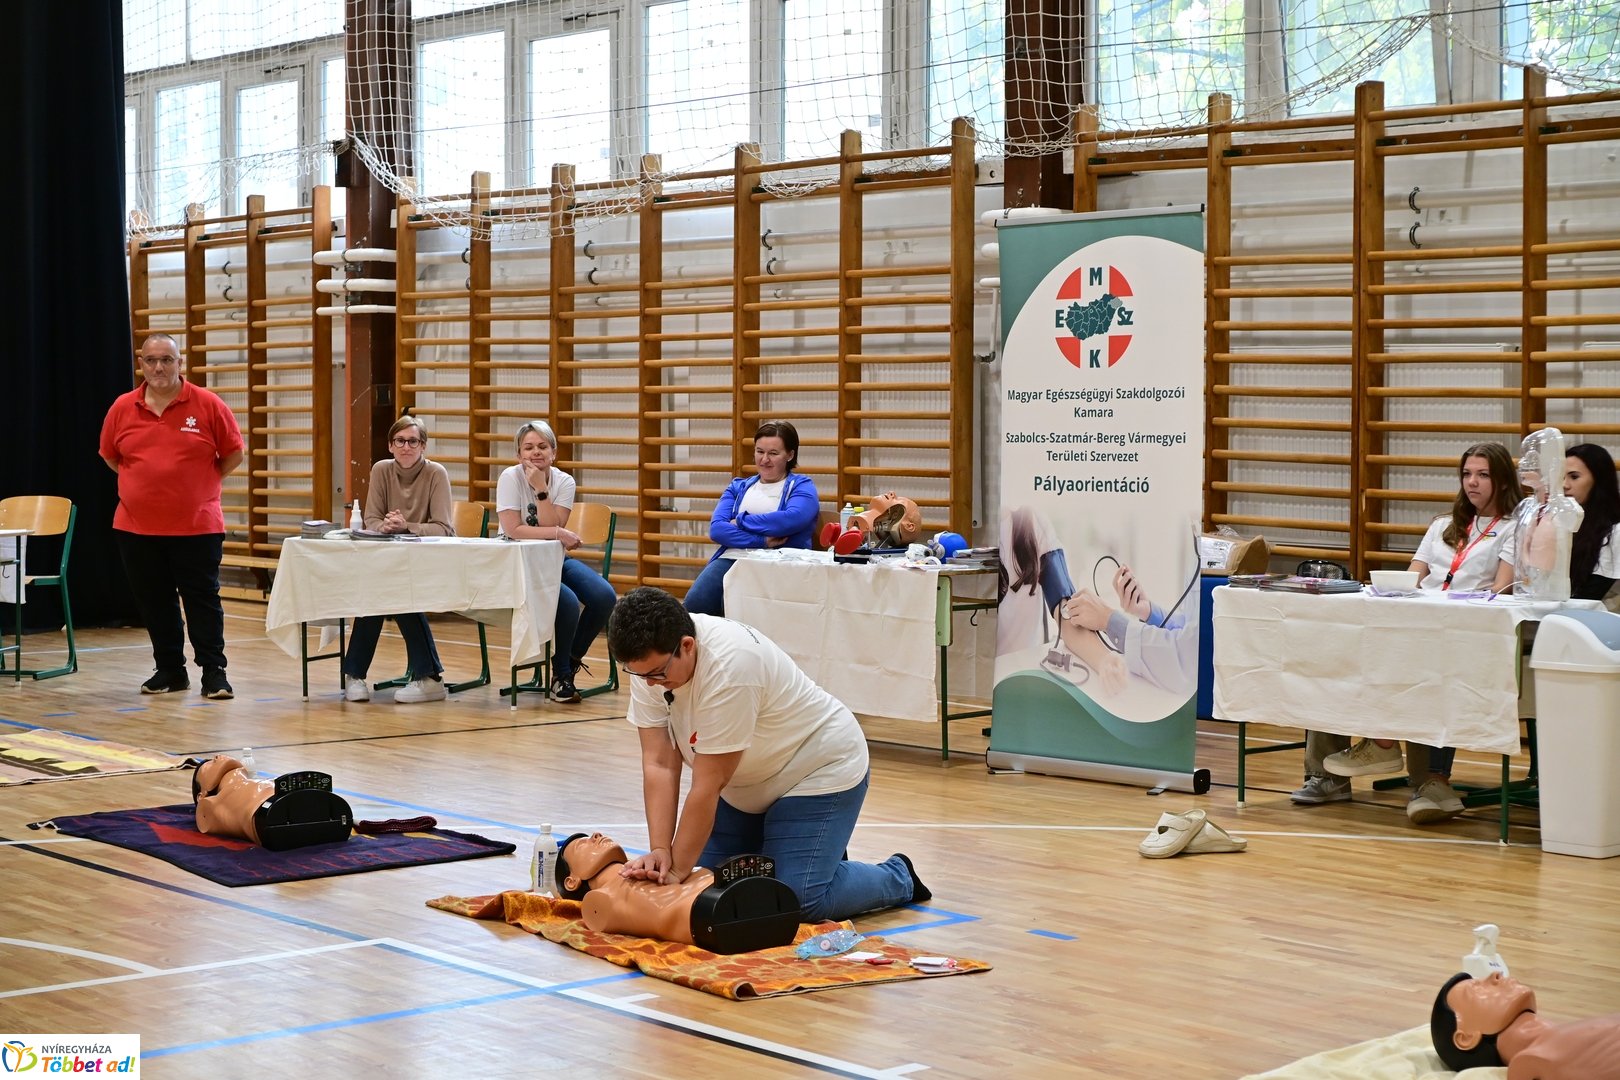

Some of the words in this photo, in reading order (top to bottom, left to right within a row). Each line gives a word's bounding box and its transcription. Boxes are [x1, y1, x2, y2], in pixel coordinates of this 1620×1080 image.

[1089, 266, 1103, 287] M
[1055, 309, 1065, 328] E
[1089, 349, 1101, 368] K
[1007, 389, 1043, 403] Magyar
[1046, 388, 1114, 403] Egészségügyi
[1115, 386, 1185, 402] Szakdolgozói
[1074, 407, 1114, 418] Kamara
[1005, 432, 1126, 447] Szabolcs-Szatmár-Bereg
[1128, 432, 1187, 447] Vármegyei
[1046, 450, 1088, 462] Területi
[1090, 450, 1139, 462] Szervezet
[1034, 475, 1150, 496] Pályaorientáció
